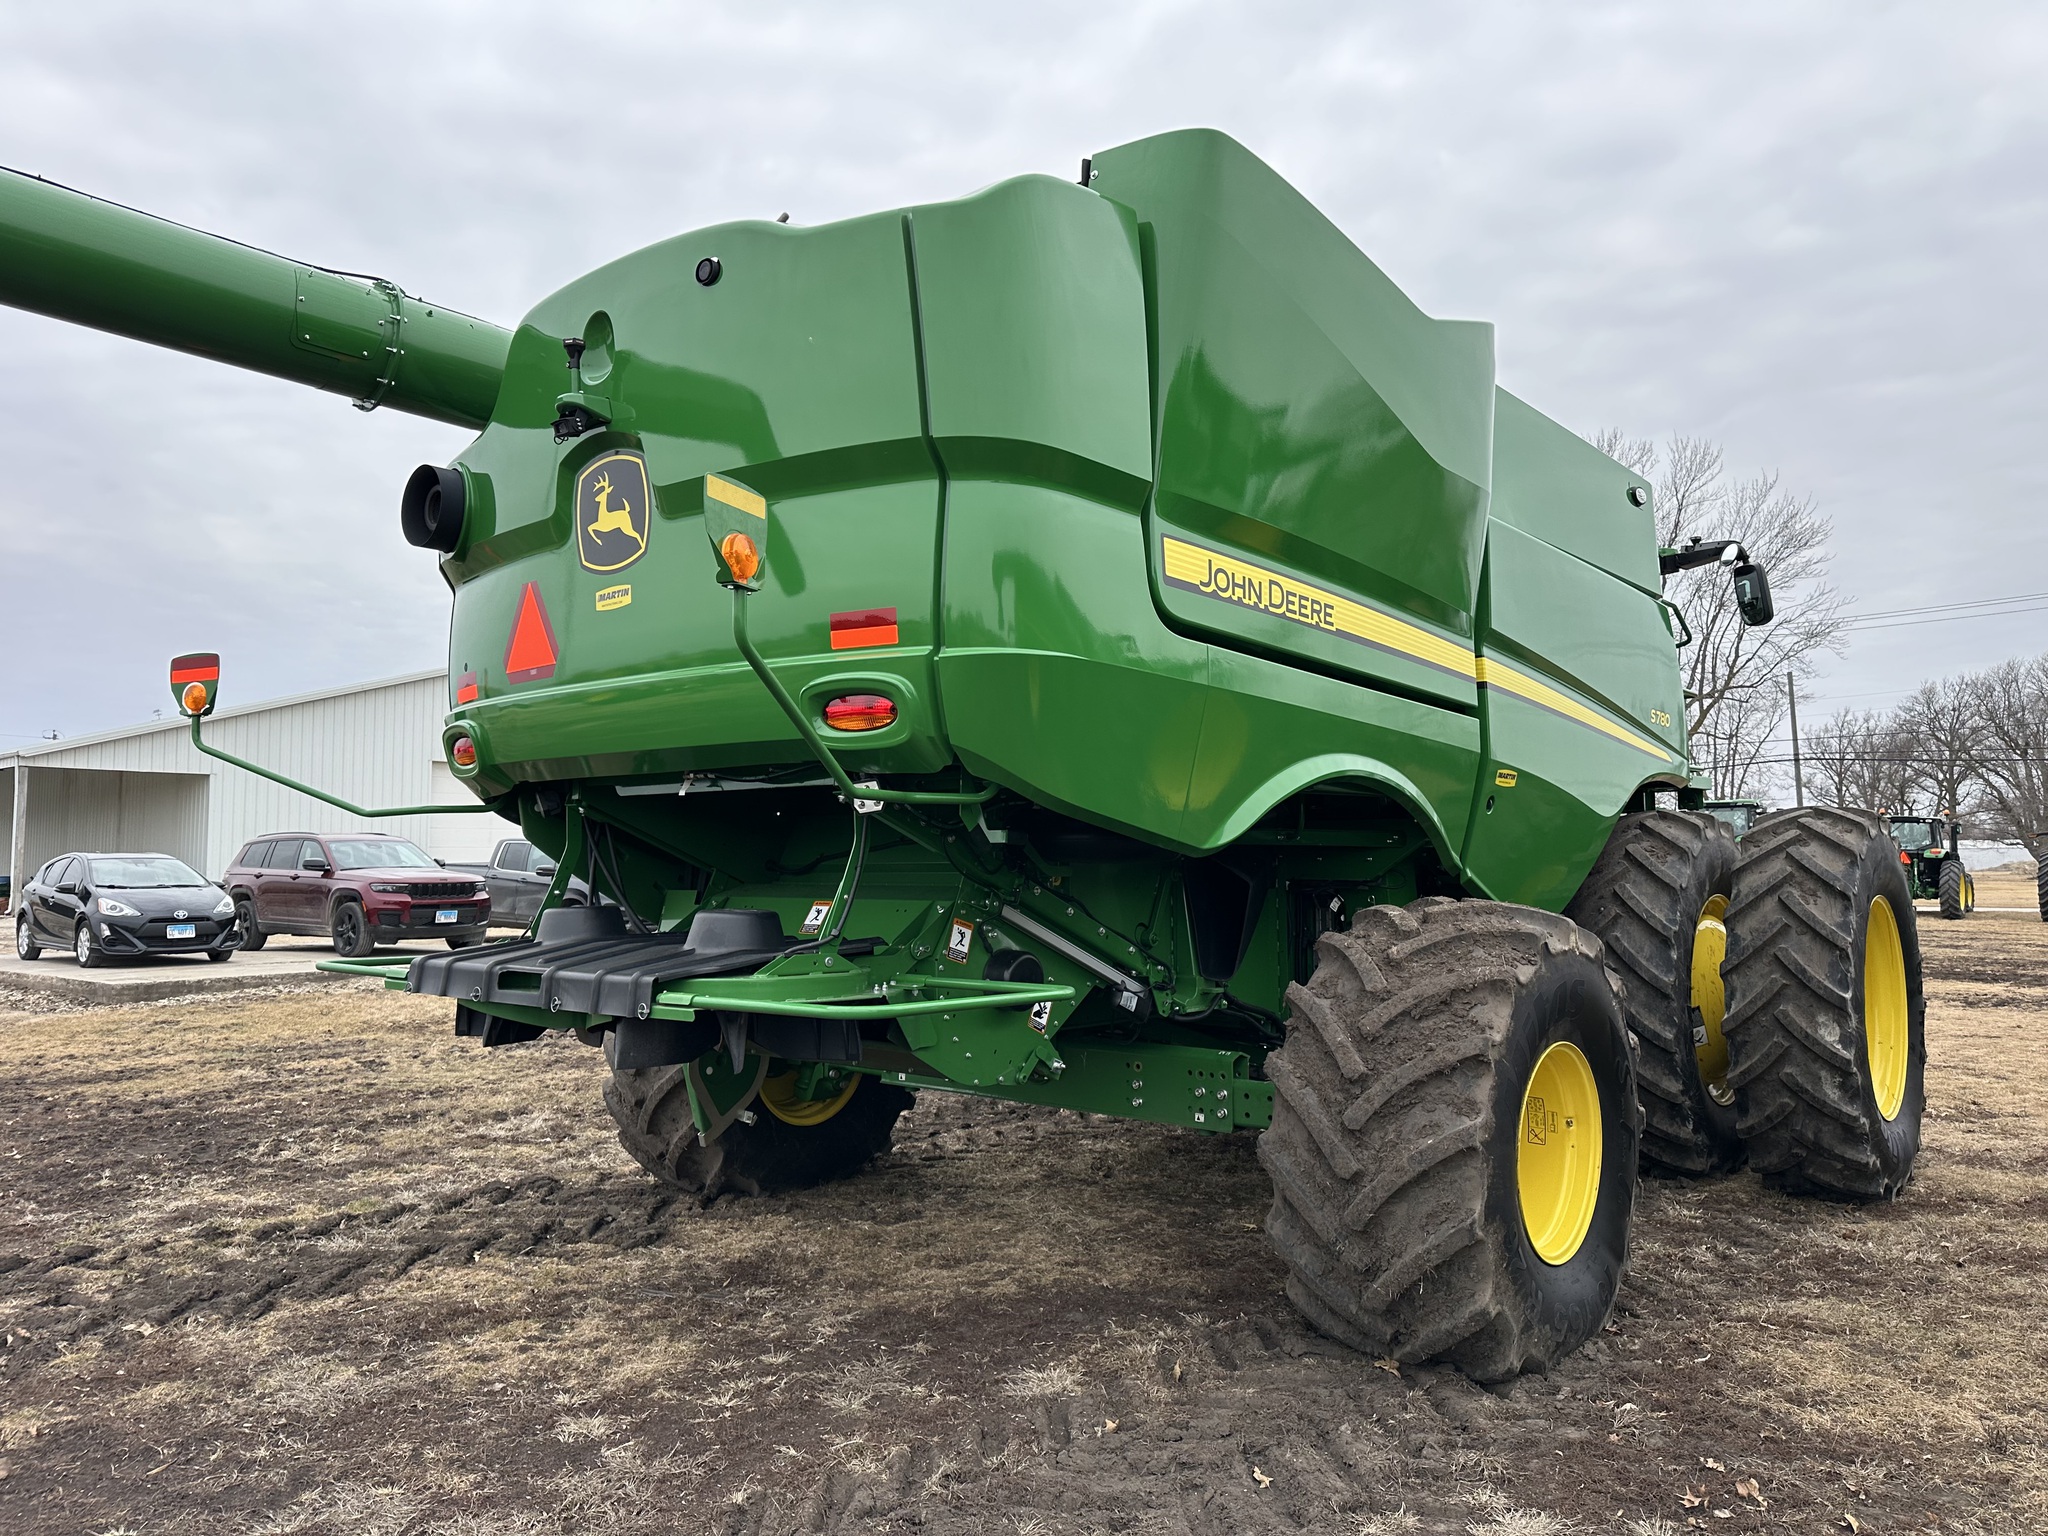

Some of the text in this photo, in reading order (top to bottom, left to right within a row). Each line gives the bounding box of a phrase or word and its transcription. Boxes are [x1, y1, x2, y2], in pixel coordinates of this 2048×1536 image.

[597, 587, 630, 602] MARTIN
[1199, 558, 1336, 628] JOHN DEERE
[1650, 708, 1671, 728] S780
